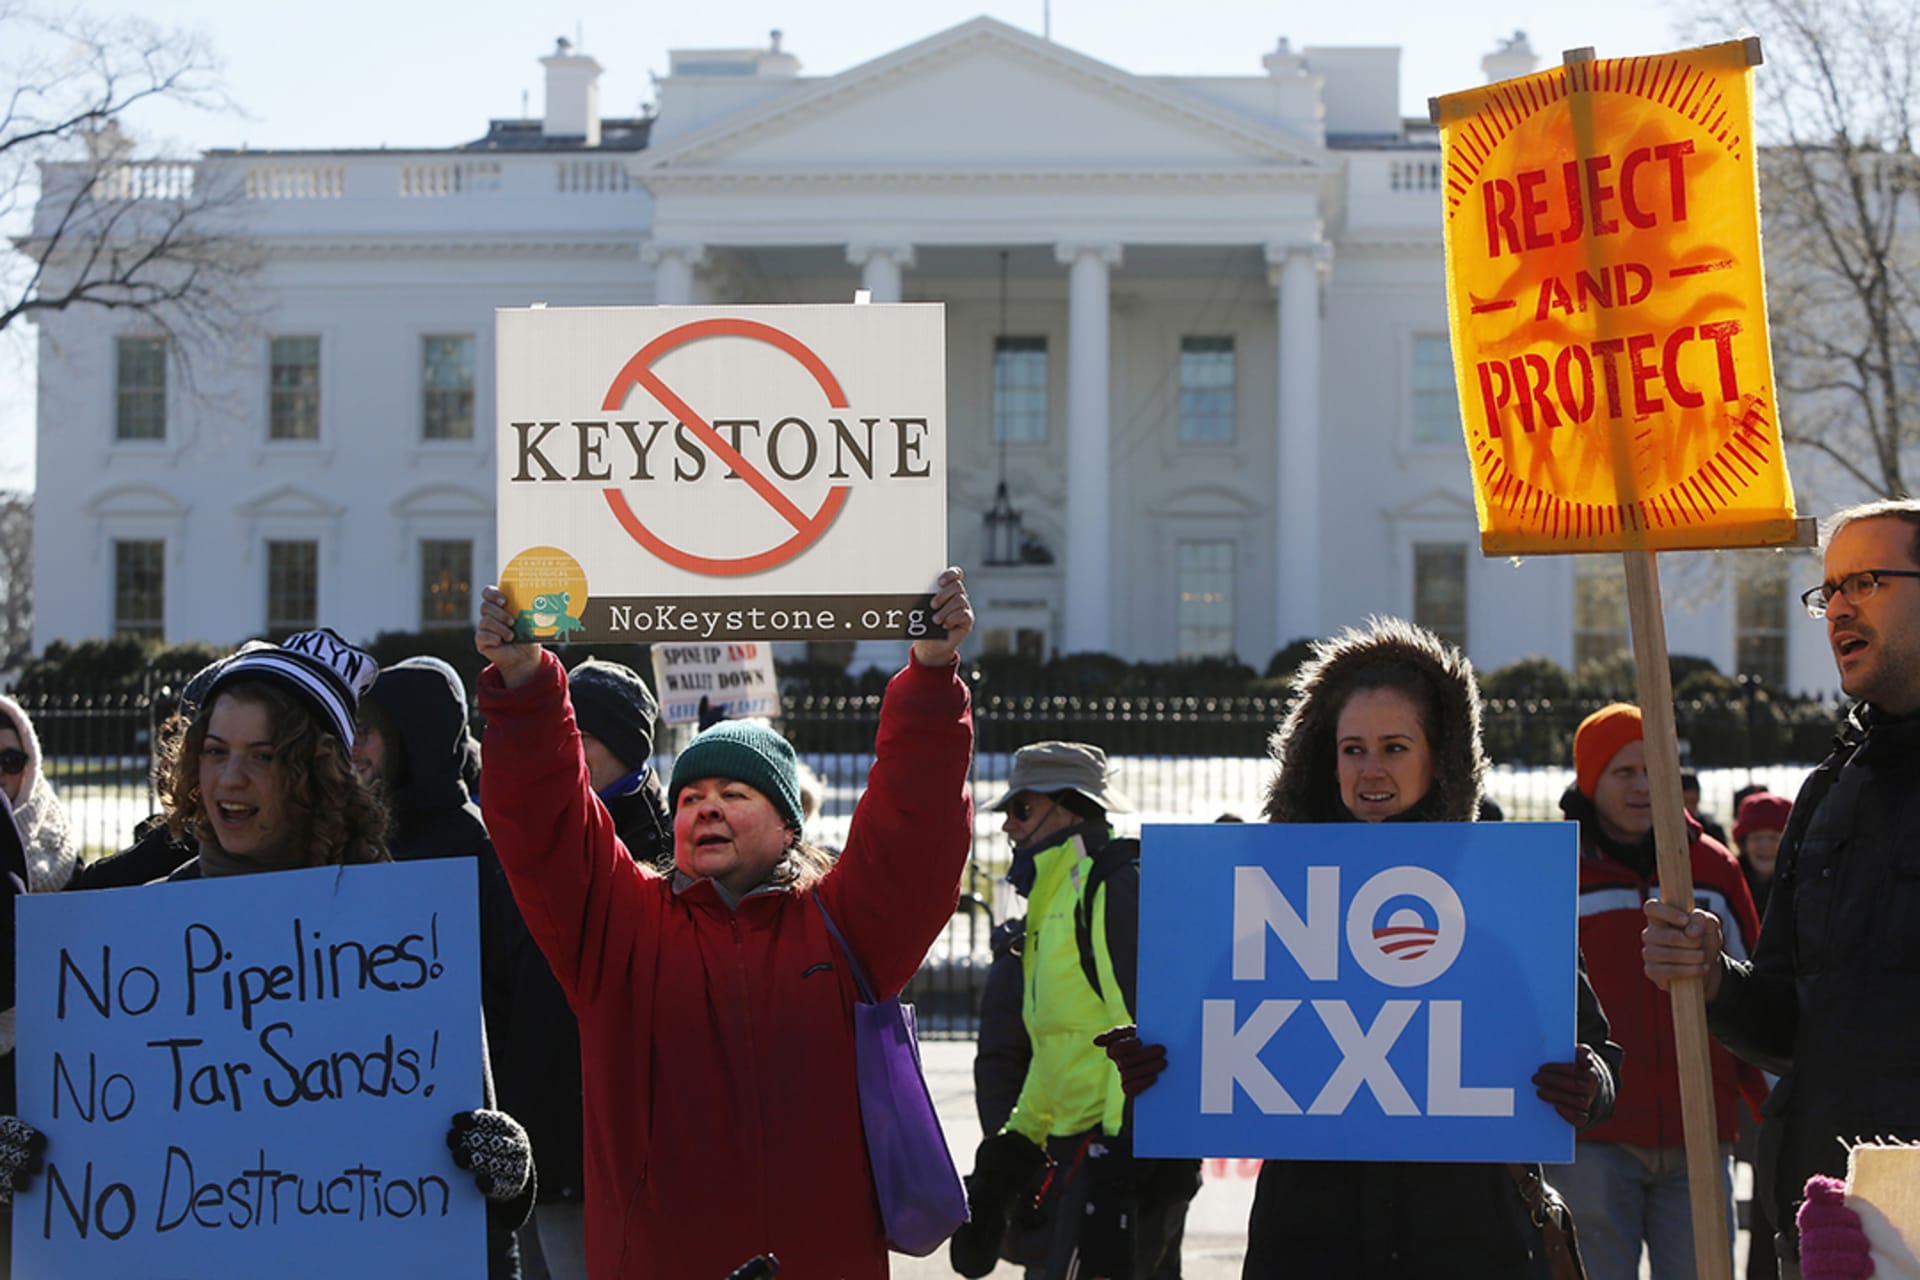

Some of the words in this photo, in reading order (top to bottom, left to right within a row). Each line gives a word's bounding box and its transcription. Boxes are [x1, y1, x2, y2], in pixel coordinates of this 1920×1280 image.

[1481, 138, 1695, 258] REJECT
[1535, 262, 1653, 322] AND
[1477, 319, 1743, 438] PROTECT
[511, 417, 931, 482] KEYSTONE
[609, 604, 928, 638] NoKeystone.org
[727, 642, 757, 661] AND
[718, 669, 765, 689] DOWN
[56, 944, 160, 1021] No
[185, 911, 445, 1031] Pipelines!
[1233, 866, 1466, 987] NO
[51, 1051, 136, 1124] No
[147, 1038, 252, 1112] Tar
[258, 1022, 440, 1108] Sands!
[1201, 999, 1515, 1116] KXL
[43, 1160, 136, 1241] No
[155, 1145, 451, 1234] Destruction
